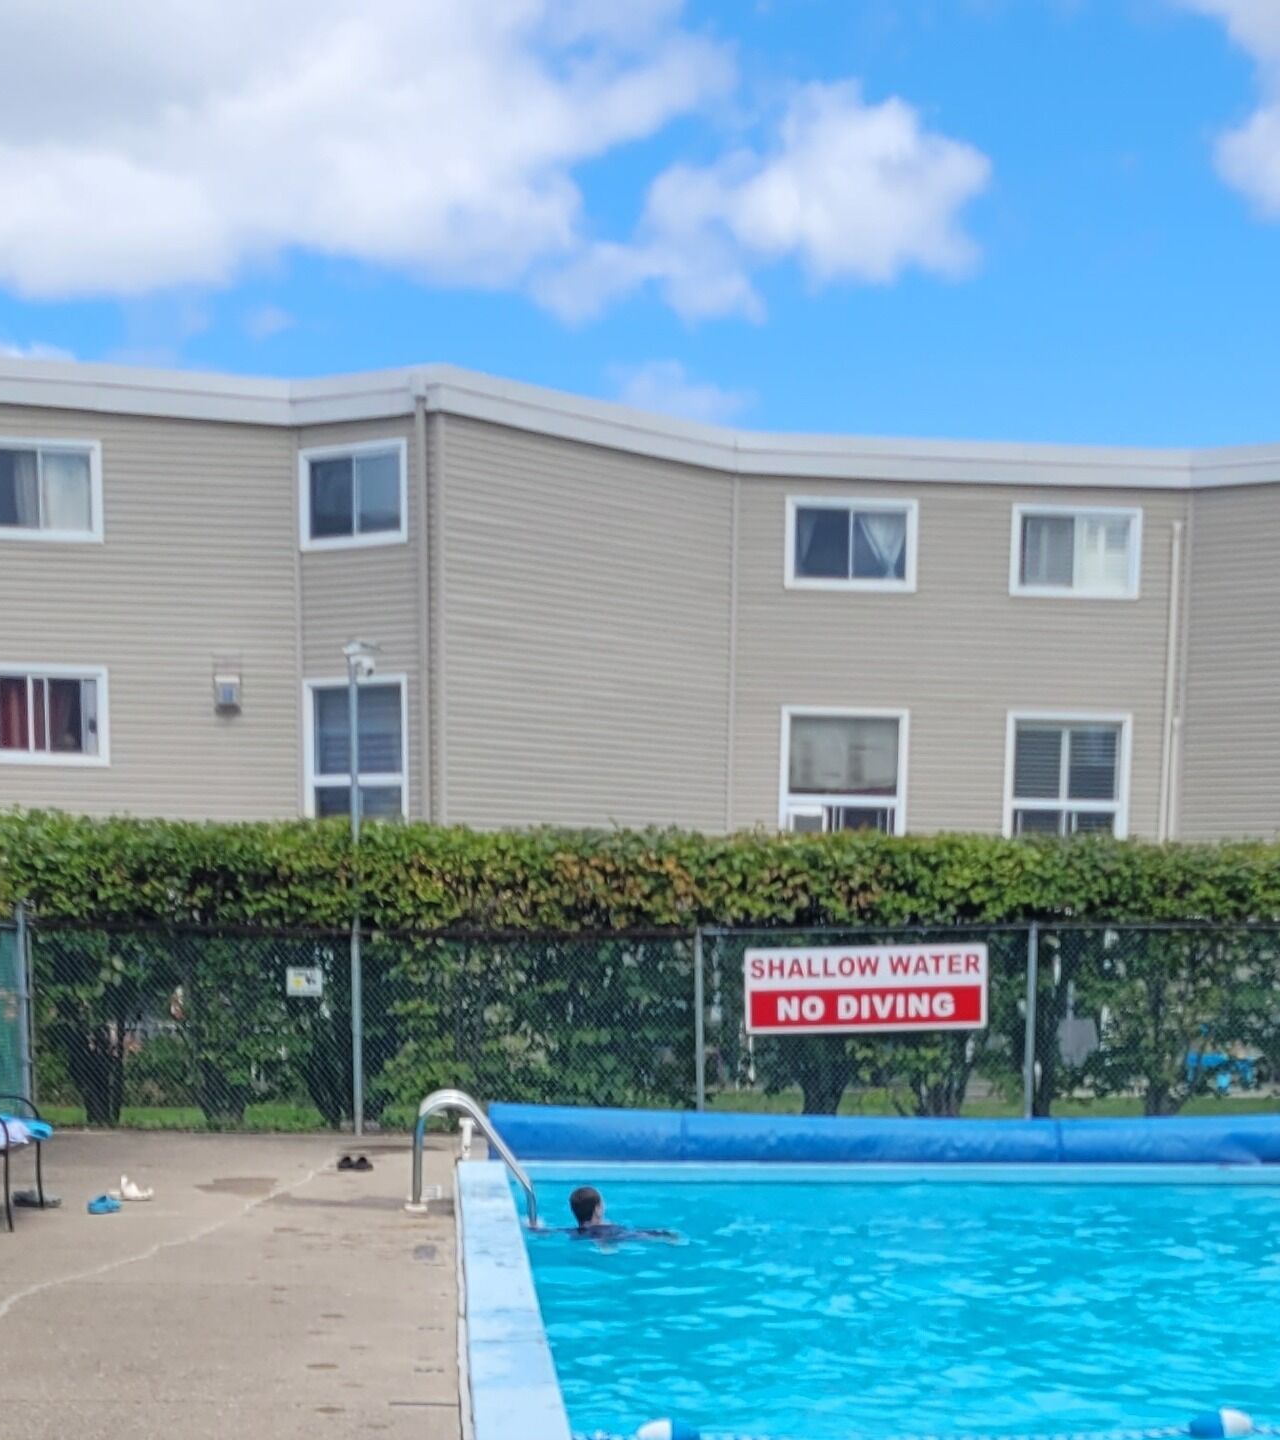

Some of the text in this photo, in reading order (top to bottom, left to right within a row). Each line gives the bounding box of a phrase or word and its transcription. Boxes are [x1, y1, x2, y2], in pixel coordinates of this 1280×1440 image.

[750, 953, 980, 980] SHALLOW WATER
[776, 992, 956, 1022] NO DIVING
